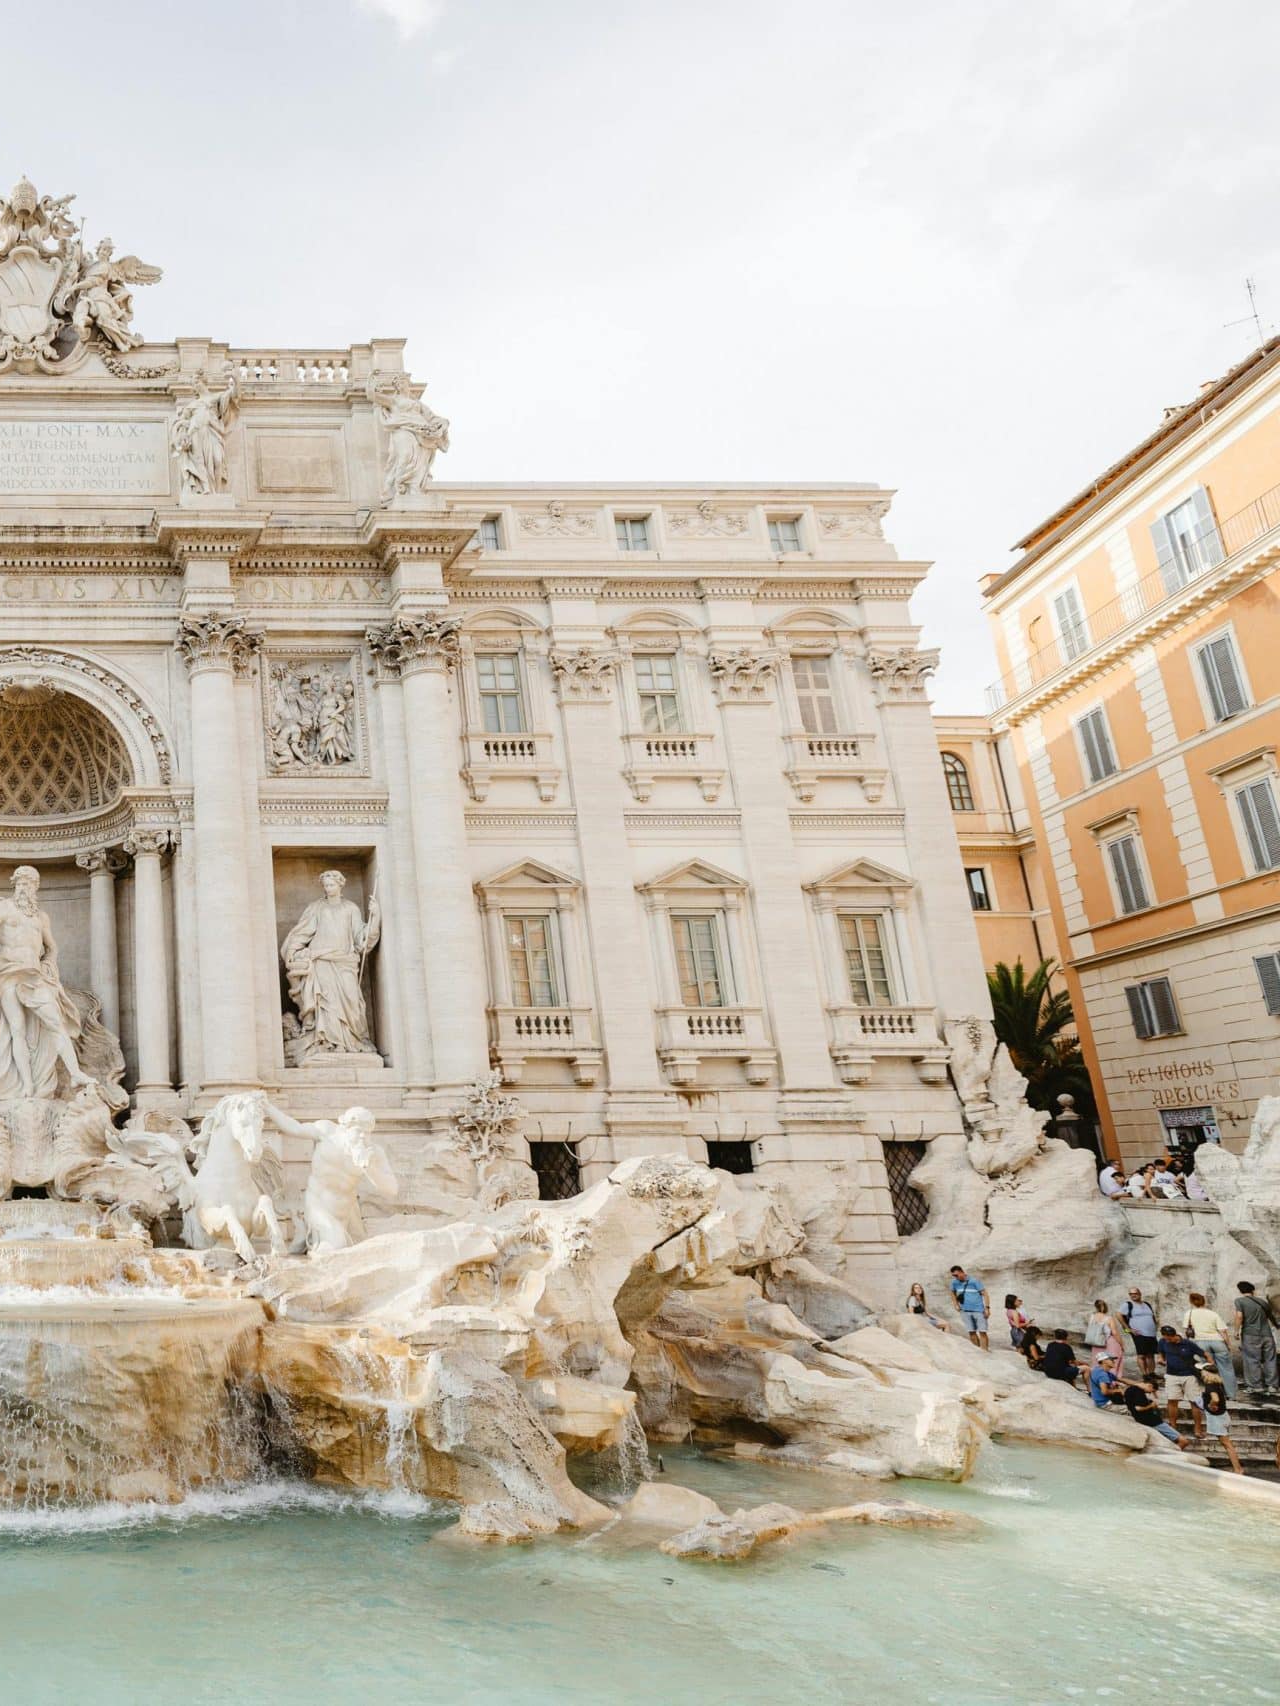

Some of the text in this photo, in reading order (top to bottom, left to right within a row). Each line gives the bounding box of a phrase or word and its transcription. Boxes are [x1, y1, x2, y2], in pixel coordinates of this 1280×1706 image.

[20, 440, 88, 450] VIRGINEM
[50, 453, 156, 464] COMMENDATAM
[1126, 1059, 1215, 1085] RELIGIOUS
[1152, 1082, 1241, 1106] ARTICLES
